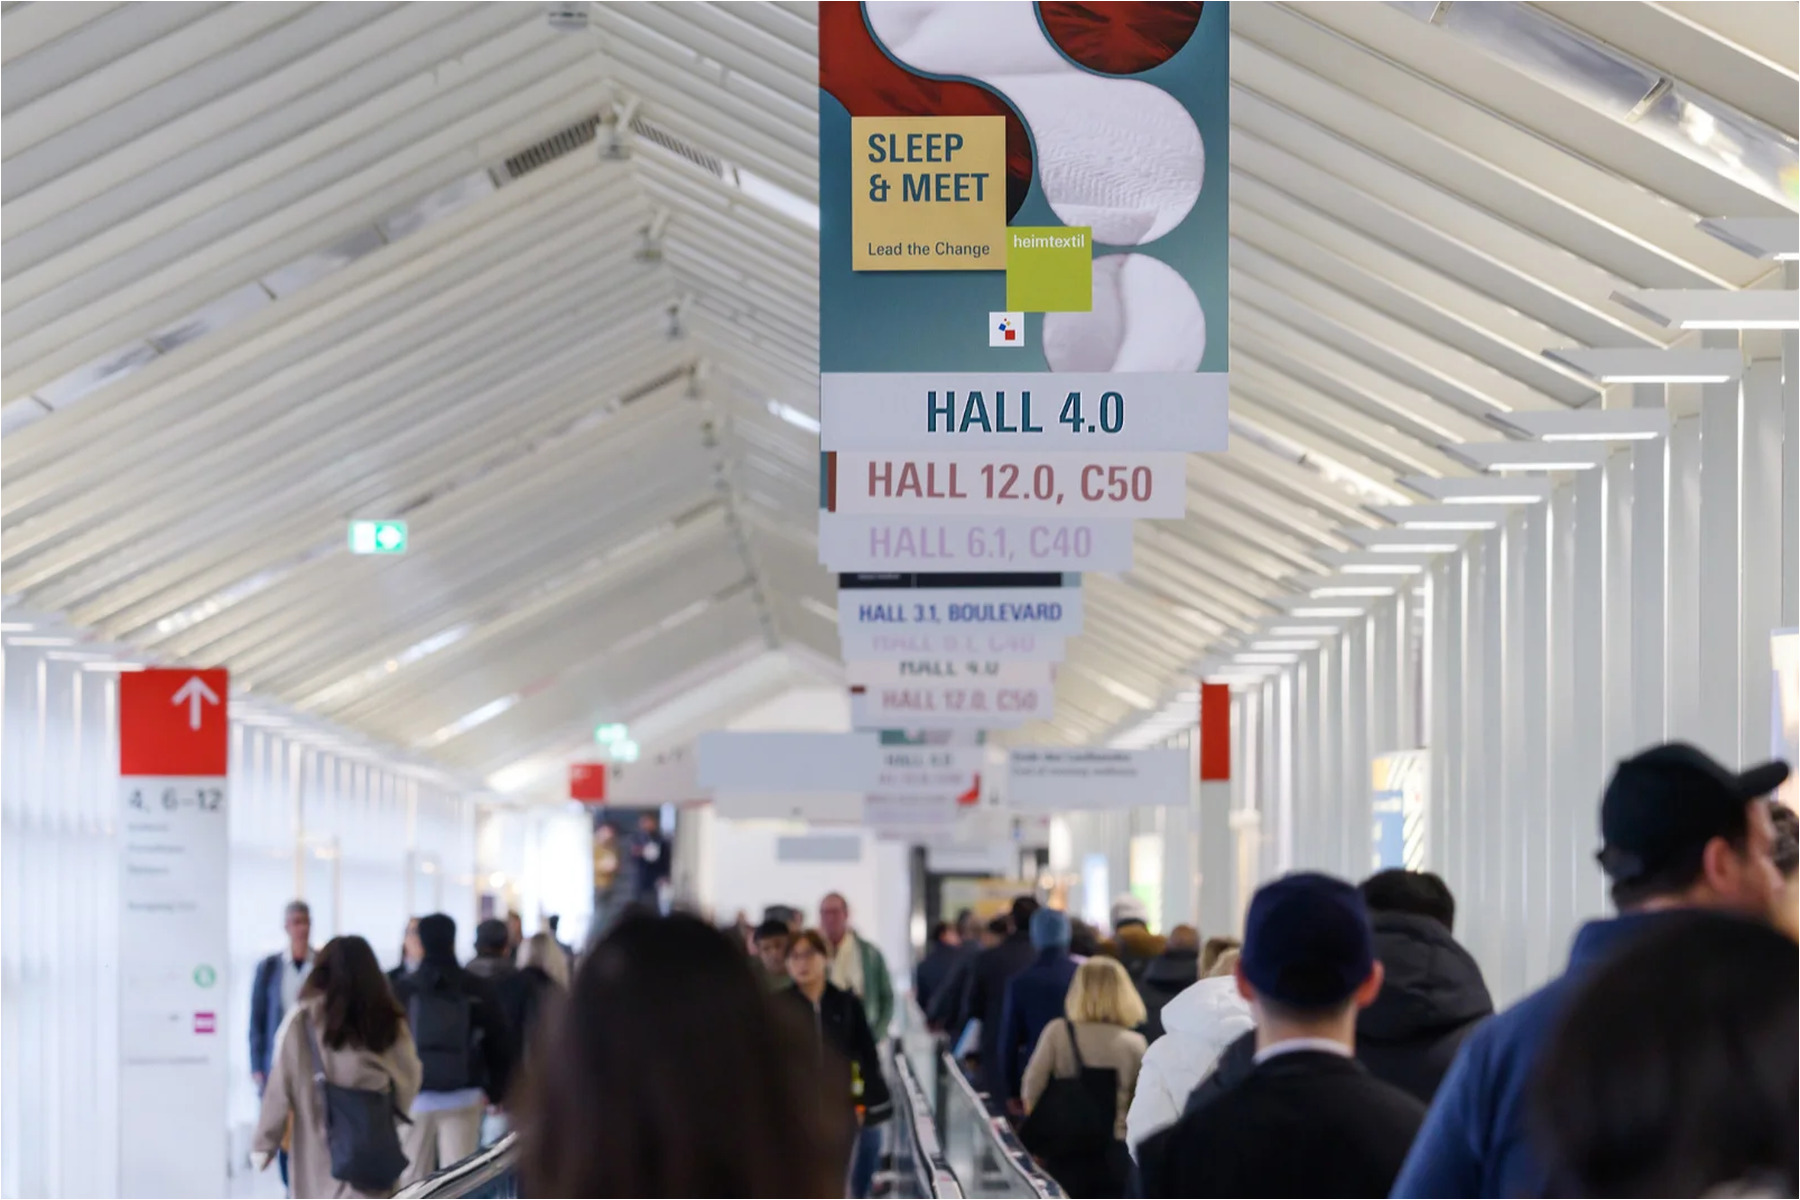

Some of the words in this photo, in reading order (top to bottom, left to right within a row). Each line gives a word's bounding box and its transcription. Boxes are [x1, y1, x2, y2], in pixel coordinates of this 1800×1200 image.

[868, 133, 964, 163] SLEEP
[869, 173, 891, 203] &
[902, 173, 990, 202] MEET
[868, 242, 902, 256] Lead
[907, 242, 930, 256] the
[935, 242, 990, 260] Change
[1013, 234, 1085, 249] heimtextil
[927, 391, 1043, 433] HALL
[1059, 391, 1125, 433] 4.0
[868, 461, 967, 498] HALL
[980, 464, 1064, 505] 12.0,
[1080, 464, 1153, 502] C50
[869, 526, 954, 559] HALL
[967, 527, 1015, 562] 6.1,
[1029, 527, 1092, 559] C40
[859, 603, 908, 622] HALL
[948, 602, 1063, 622] BOULEVARD
[899, 659, 957, 675] HALL
[882, 689, 936, 711] HALL
[997, 689, 1038, 711] C50
